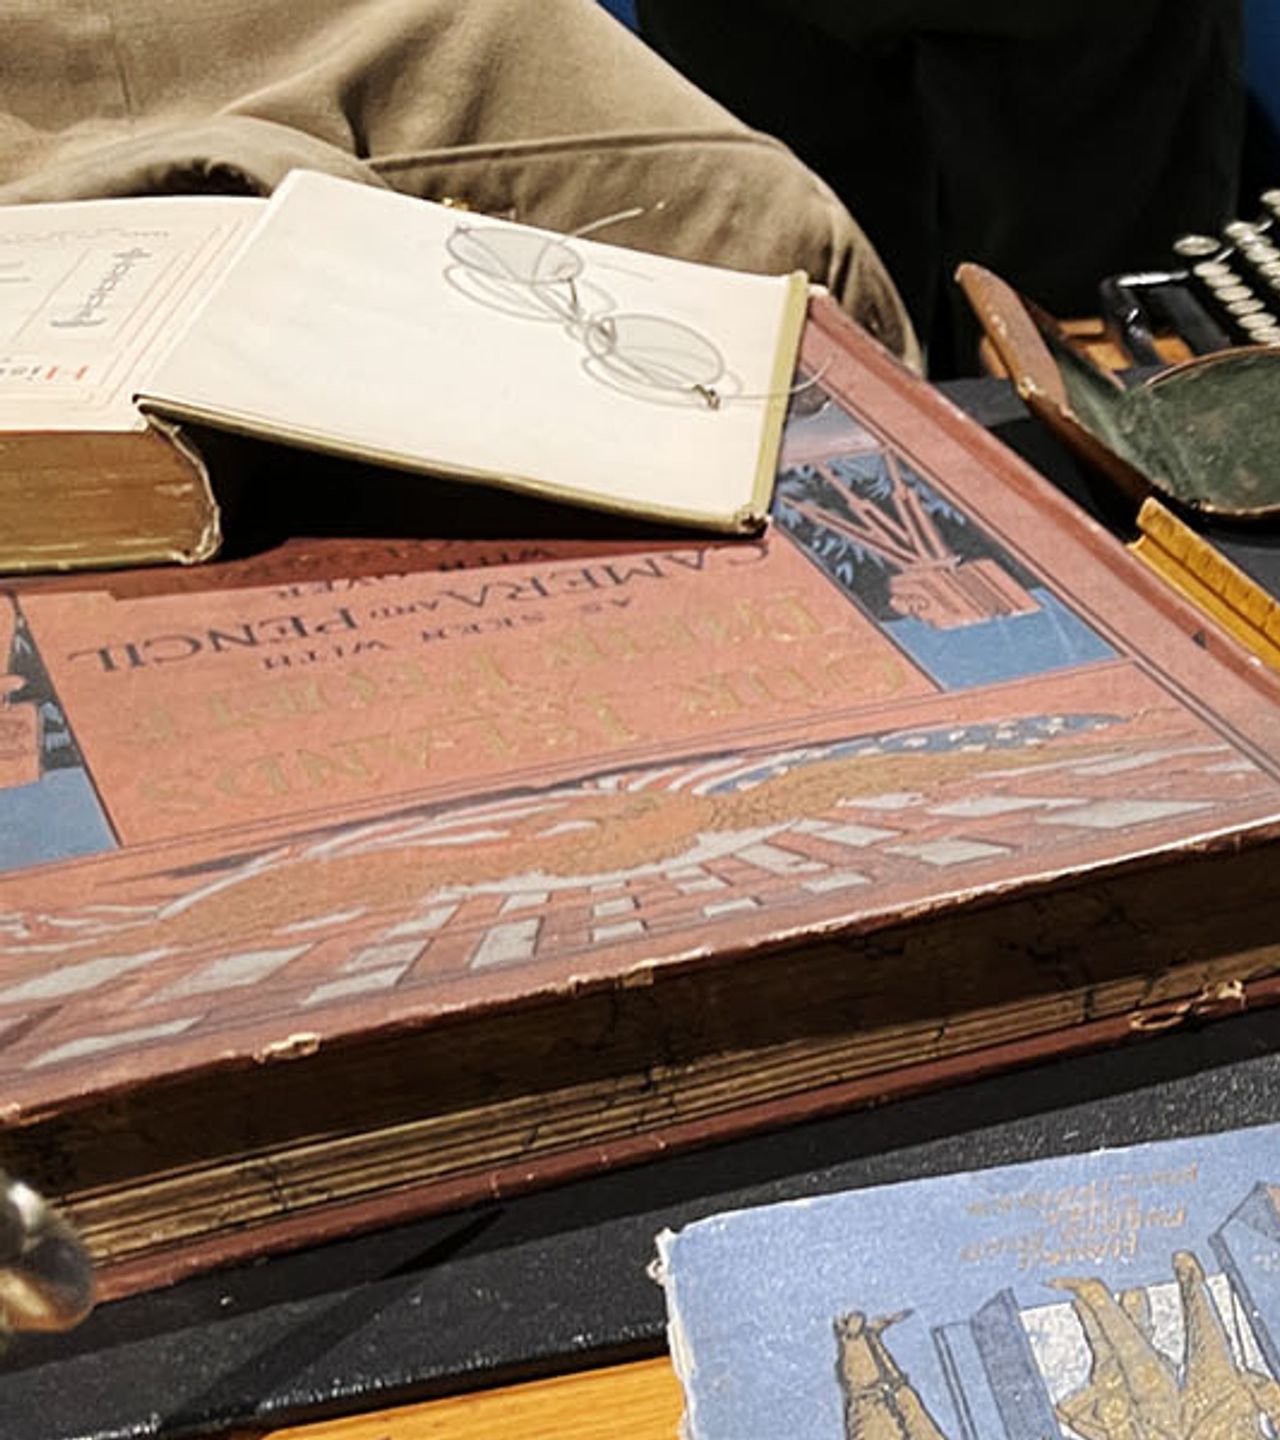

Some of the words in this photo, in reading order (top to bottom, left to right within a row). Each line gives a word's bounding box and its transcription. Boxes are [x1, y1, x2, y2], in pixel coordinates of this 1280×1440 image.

[438, 542, 770, 610] CAMERA
[368, 598, 439, 621] AND
[420, 609, 544, 642] SEEN
[66, 607, 357, 673] PENCIL
[259, 639, 392, 670] WITH
